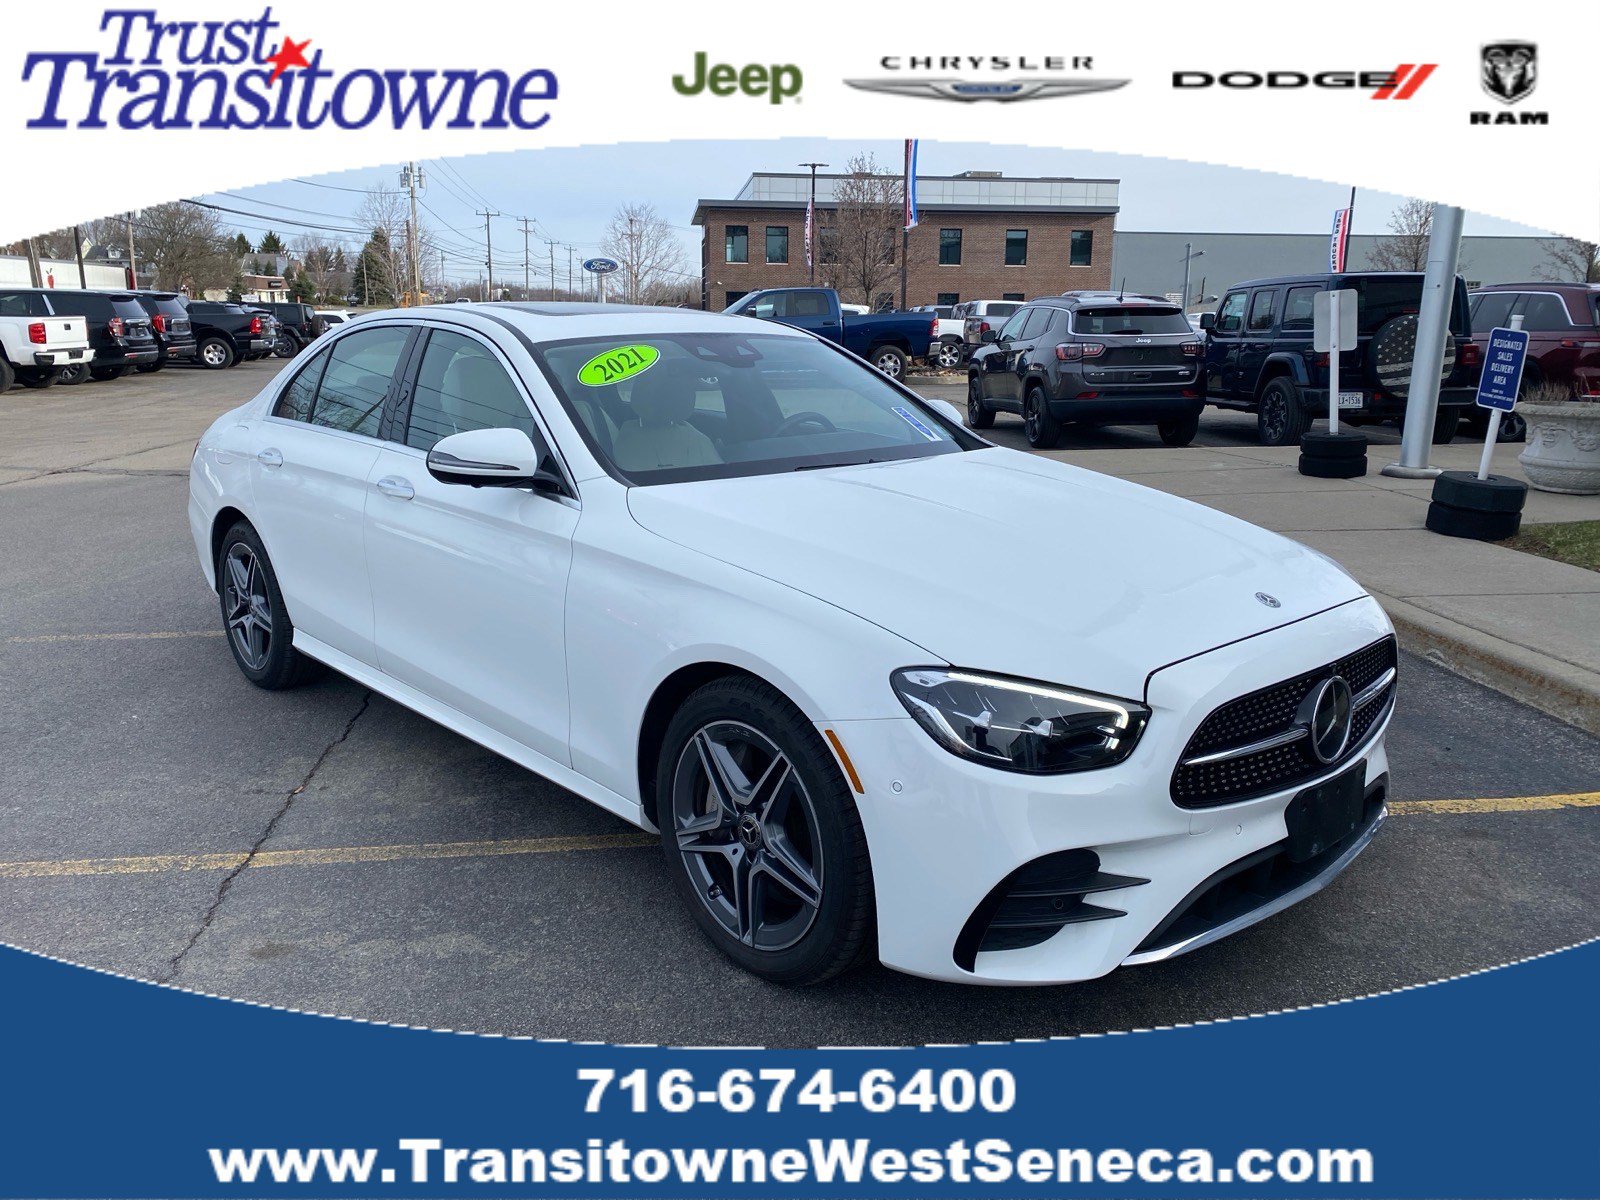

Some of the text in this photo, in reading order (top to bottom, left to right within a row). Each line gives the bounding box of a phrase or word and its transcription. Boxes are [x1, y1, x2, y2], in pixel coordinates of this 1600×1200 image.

[1493, 338, 1523, 351] DESIGNATED
[1497, 351, 1513, 362] SALES
[594, 347, 648, 382] 2021
[1490, 362, 1515, 375] DELIVERY
[1493, 375, 1507, 386] AREA
